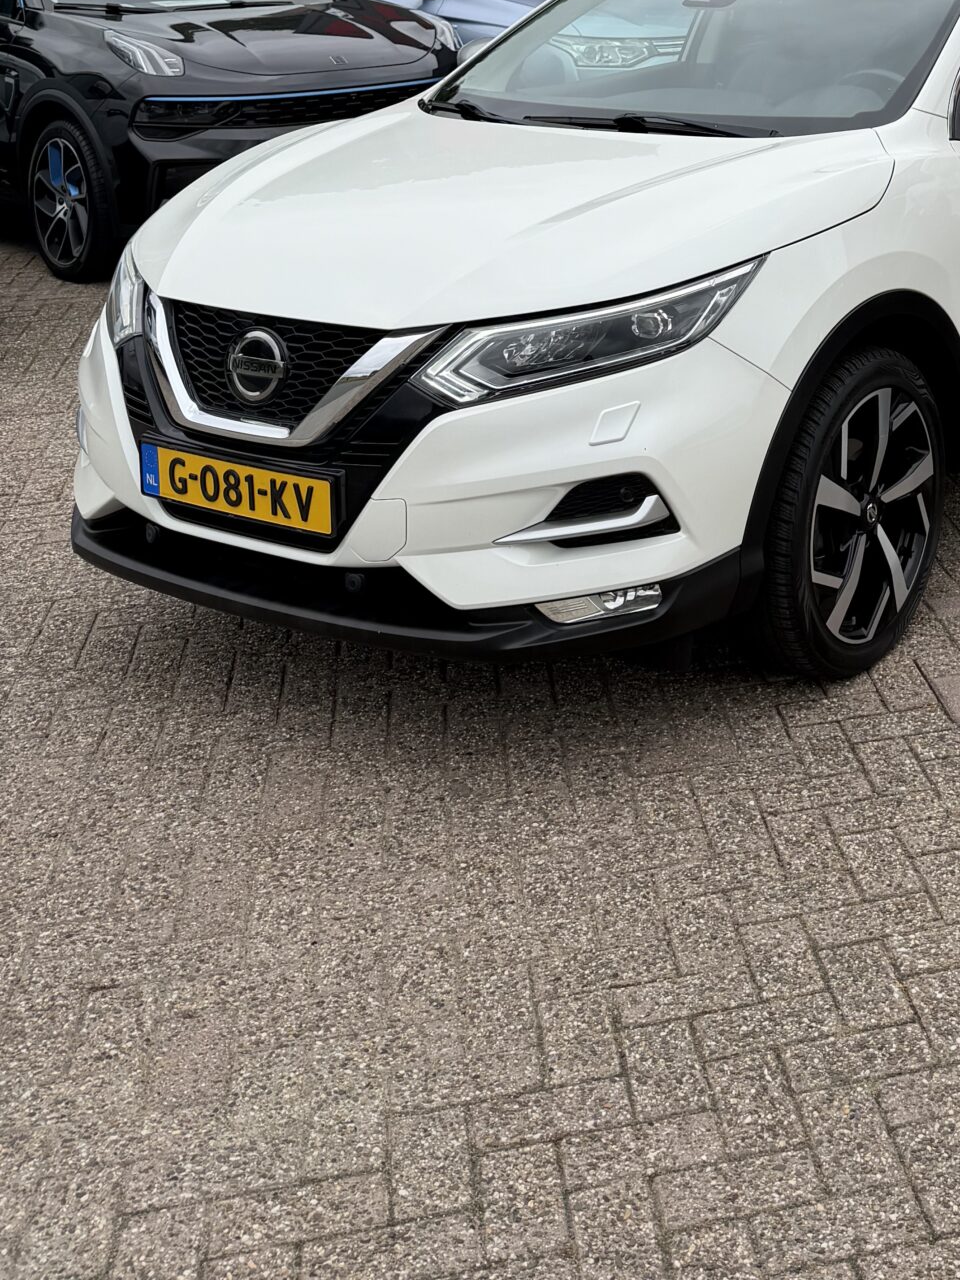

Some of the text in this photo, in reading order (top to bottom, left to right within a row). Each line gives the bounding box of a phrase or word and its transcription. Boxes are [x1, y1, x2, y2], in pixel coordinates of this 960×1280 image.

[232, 357, 278, 374] NISSAN
[146, 472, 158, 486] NL
[168, 457, 314, 522] G-081-KV
